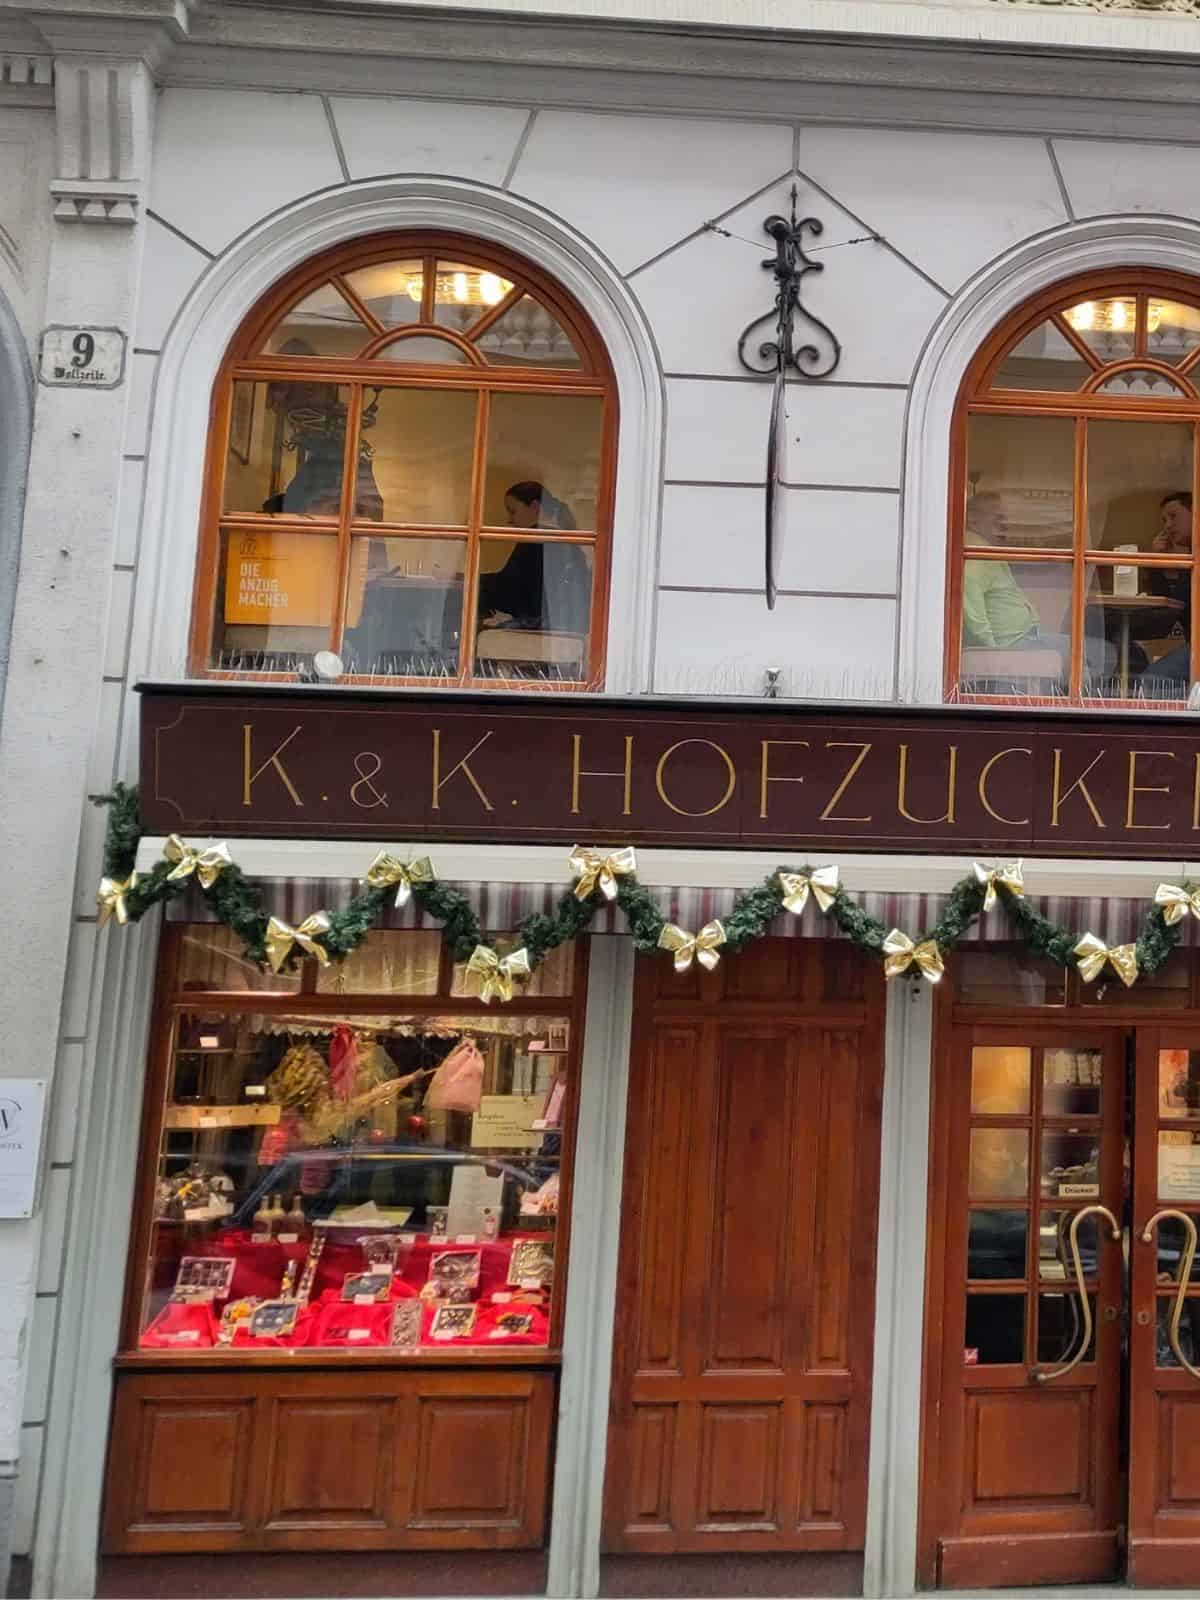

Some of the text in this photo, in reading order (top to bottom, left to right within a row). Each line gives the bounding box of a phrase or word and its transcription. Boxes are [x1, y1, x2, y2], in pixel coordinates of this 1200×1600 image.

[71, 332, 95, 368] 9
[240, 562, 261, 577] DIE
[240, 578, 279, 592] ANZUG
[238, 592, 289, 608] MACHER
[243, 724, 329, 806] K.
[350, 751, 389, 808] &
[432, 729, 519, 811] K.
